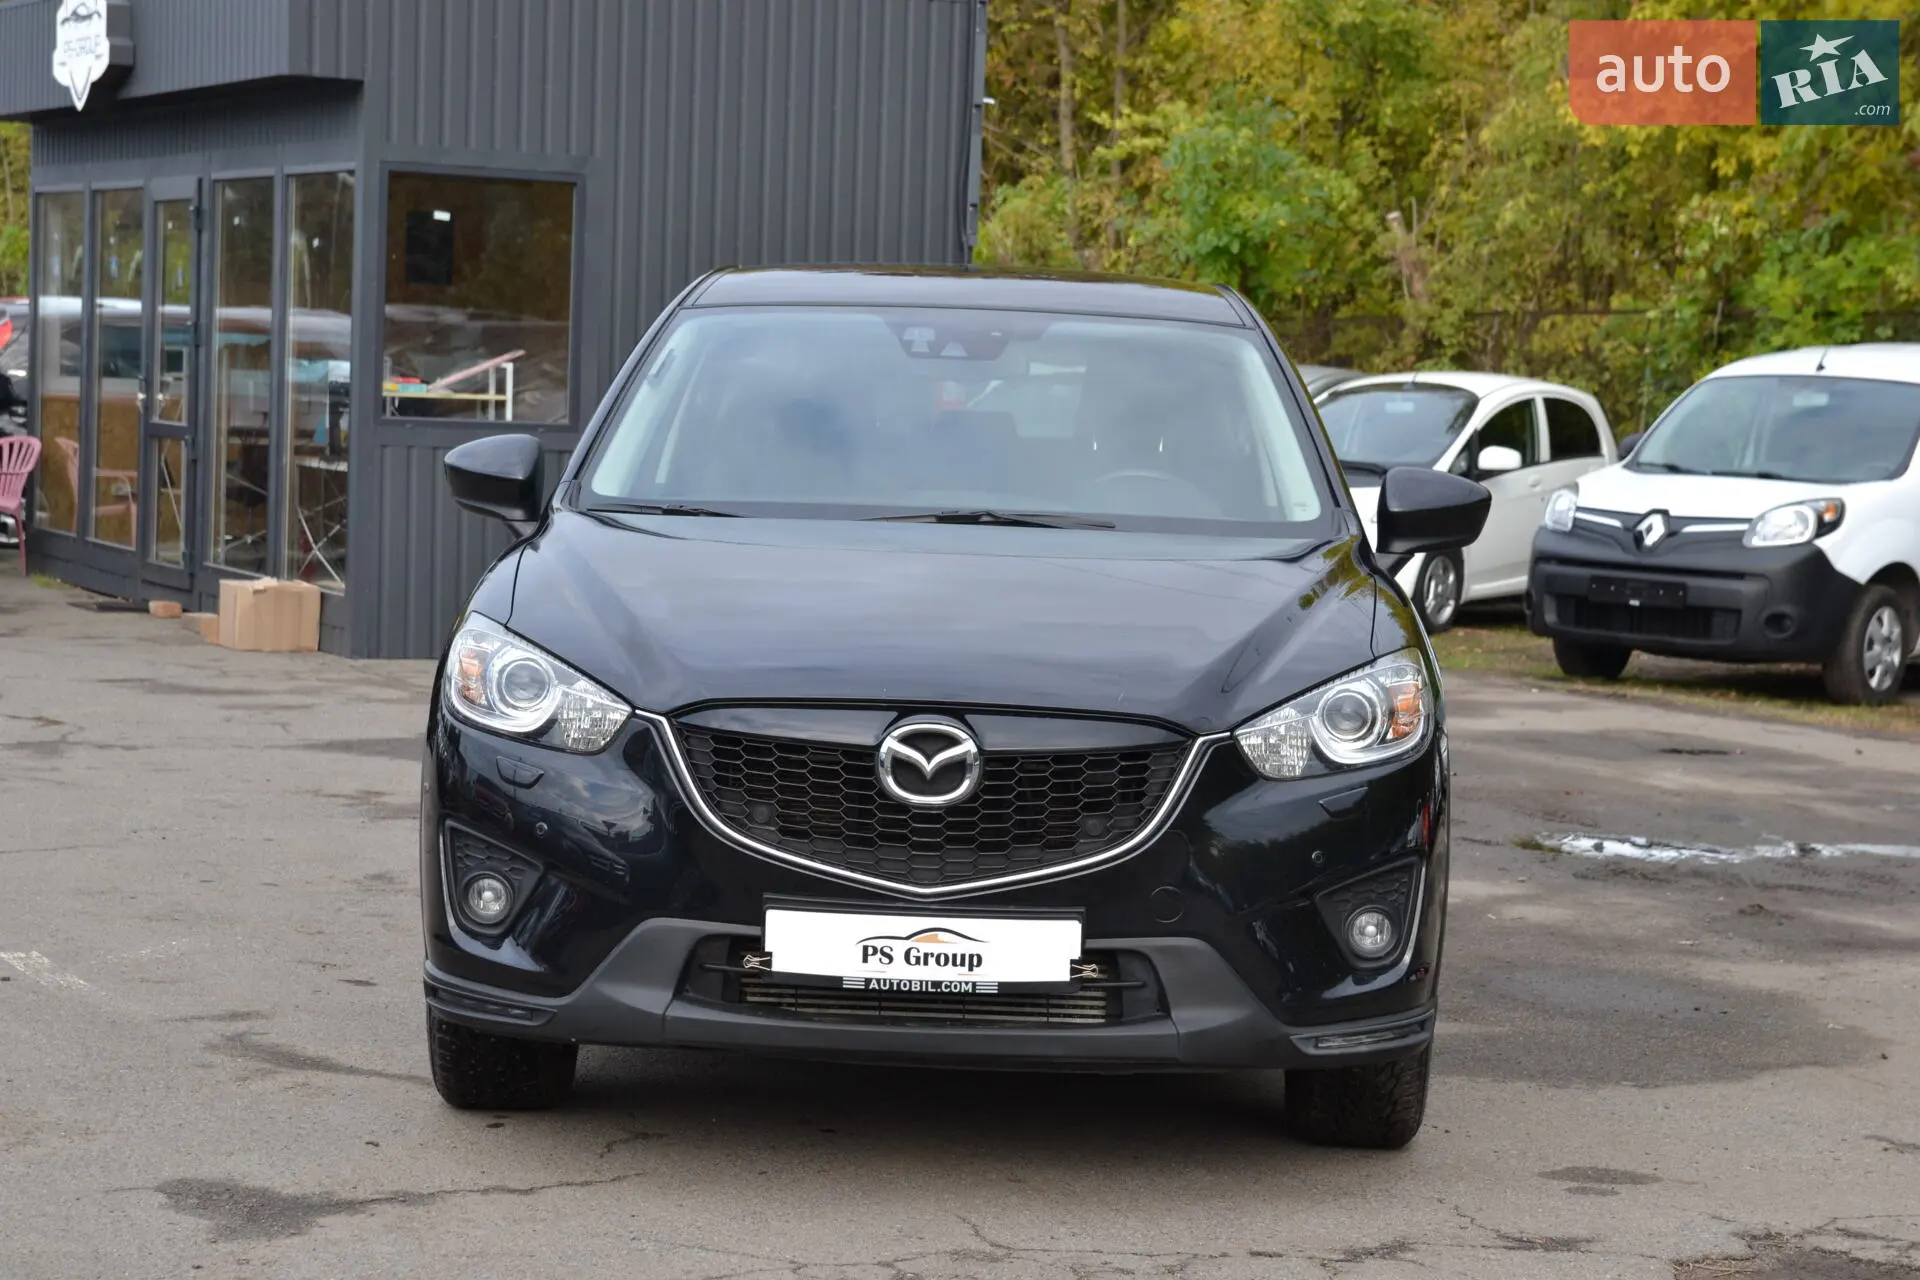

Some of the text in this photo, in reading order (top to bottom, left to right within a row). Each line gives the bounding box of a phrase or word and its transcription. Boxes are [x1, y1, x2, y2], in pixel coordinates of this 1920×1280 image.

[861, 945, 983, 972] PS Group
[869, 978, 973, 993] AUTOBIL.COM
